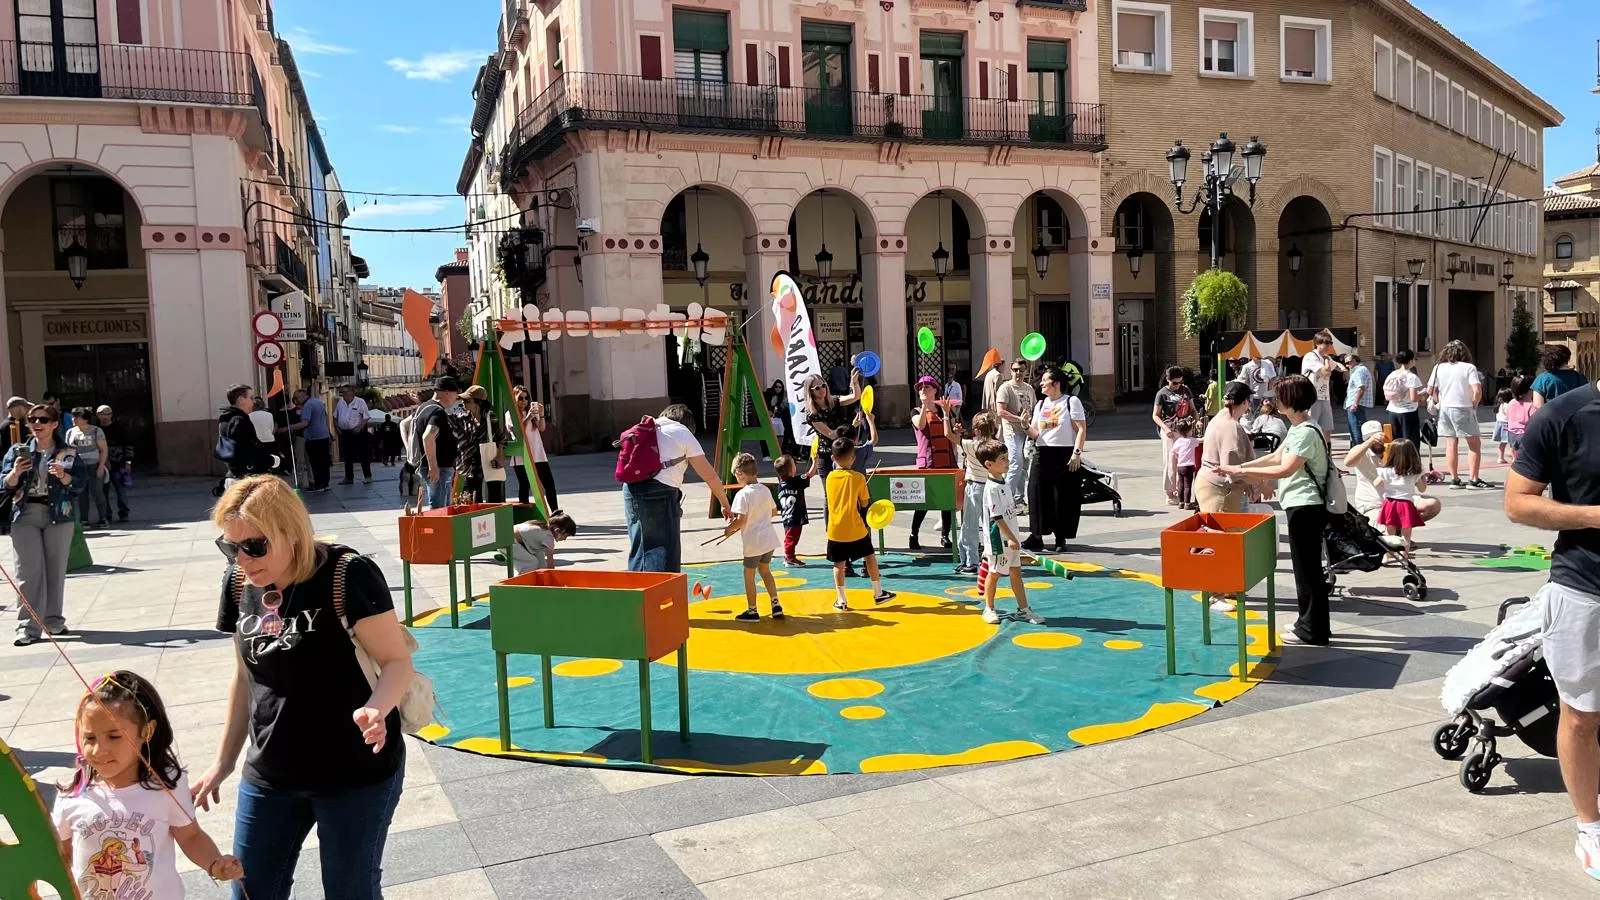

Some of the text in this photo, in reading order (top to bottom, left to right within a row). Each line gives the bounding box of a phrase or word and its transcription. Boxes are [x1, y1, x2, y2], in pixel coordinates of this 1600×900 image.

[276, 311, 301, 319] ELTINS
[46, 319, 141, 335] CONFECCIONES
[243, 635, 292, 665] Jes
[76, 810, 155, 841] RODEO
